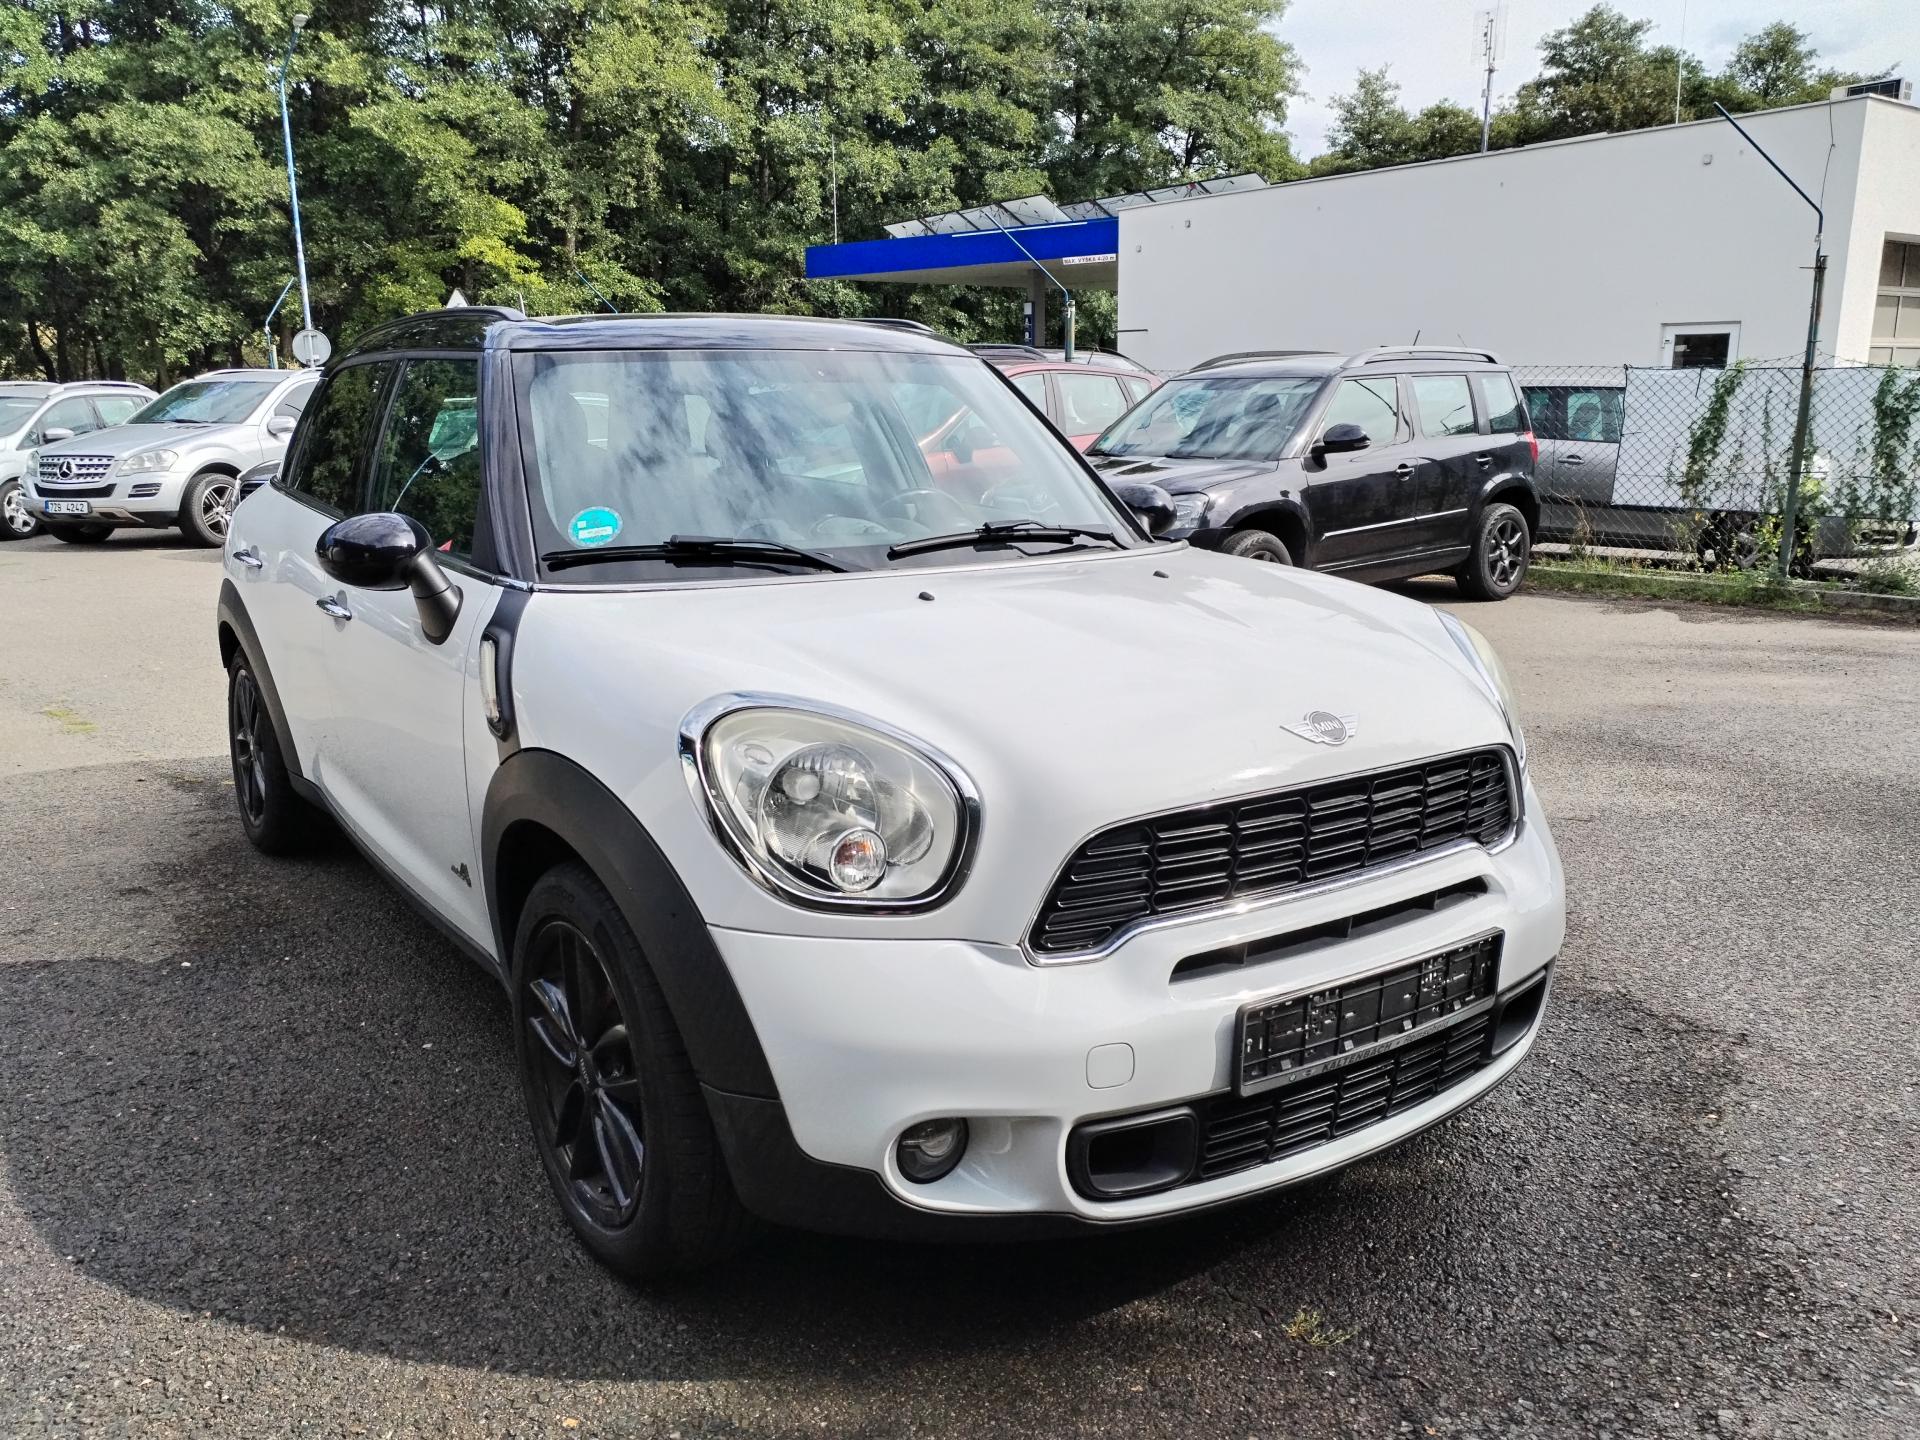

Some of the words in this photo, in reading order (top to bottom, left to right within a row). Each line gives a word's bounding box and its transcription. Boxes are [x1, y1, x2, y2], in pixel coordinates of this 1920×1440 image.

[66, 503, 84, 512] 4242
[1312, 719, 1343, 733] MINI
[1321, 1042, 1393, 1073] KALTENBACH
